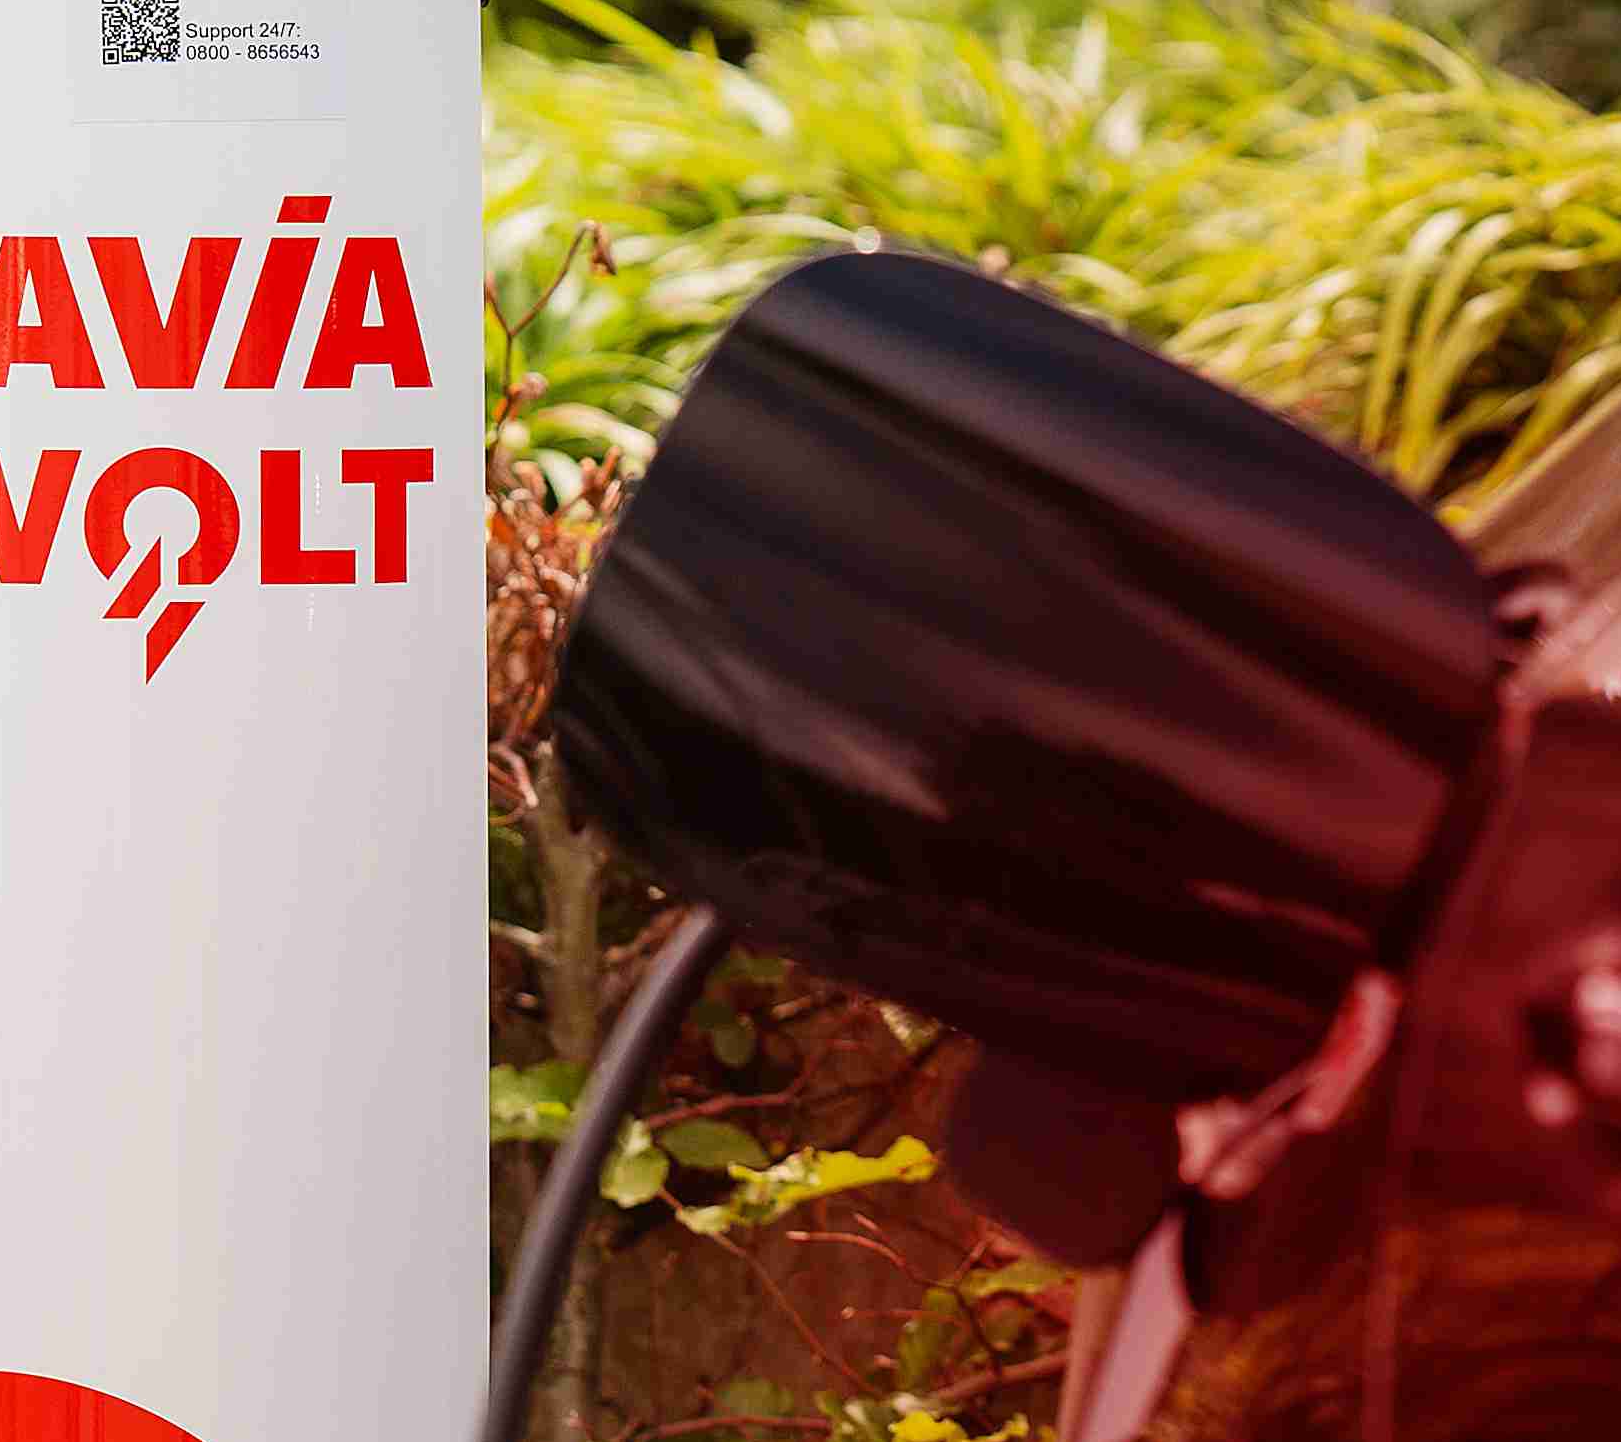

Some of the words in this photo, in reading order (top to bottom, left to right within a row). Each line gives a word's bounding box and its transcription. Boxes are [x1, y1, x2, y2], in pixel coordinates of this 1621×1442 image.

[185, 22, 254, 41] Support
[259, 22, 302, 39] 24/7:
[186, 44, 230, 61] 0800
[247, 44, 321, 61] 8656543
